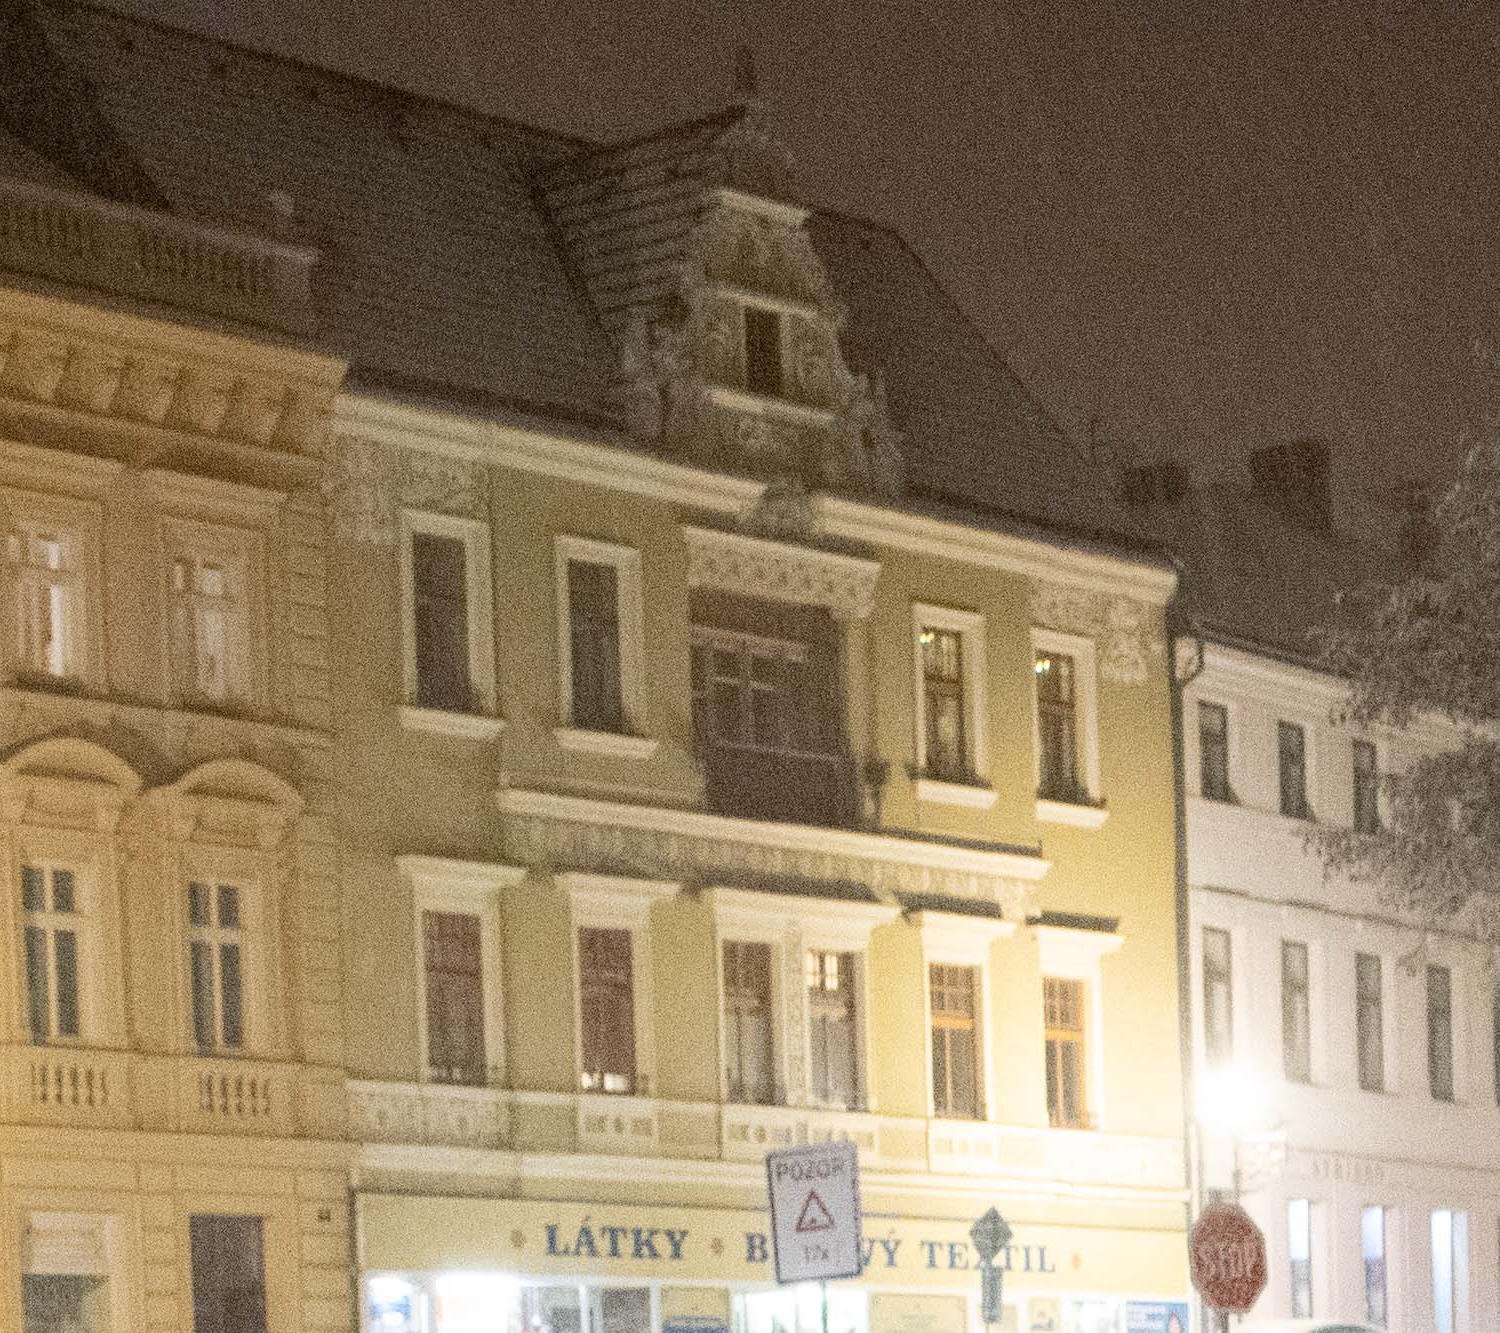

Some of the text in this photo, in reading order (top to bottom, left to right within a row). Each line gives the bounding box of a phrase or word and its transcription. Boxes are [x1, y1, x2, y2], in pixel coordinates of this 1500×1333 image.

[775, 1156, 846, 1182] POZOR
[544, 1214, 690, 1261] LÁTKY
[920, 1238, 1055, 1273] TETIL
[1198, 1237, 1258, 1281] STOP
